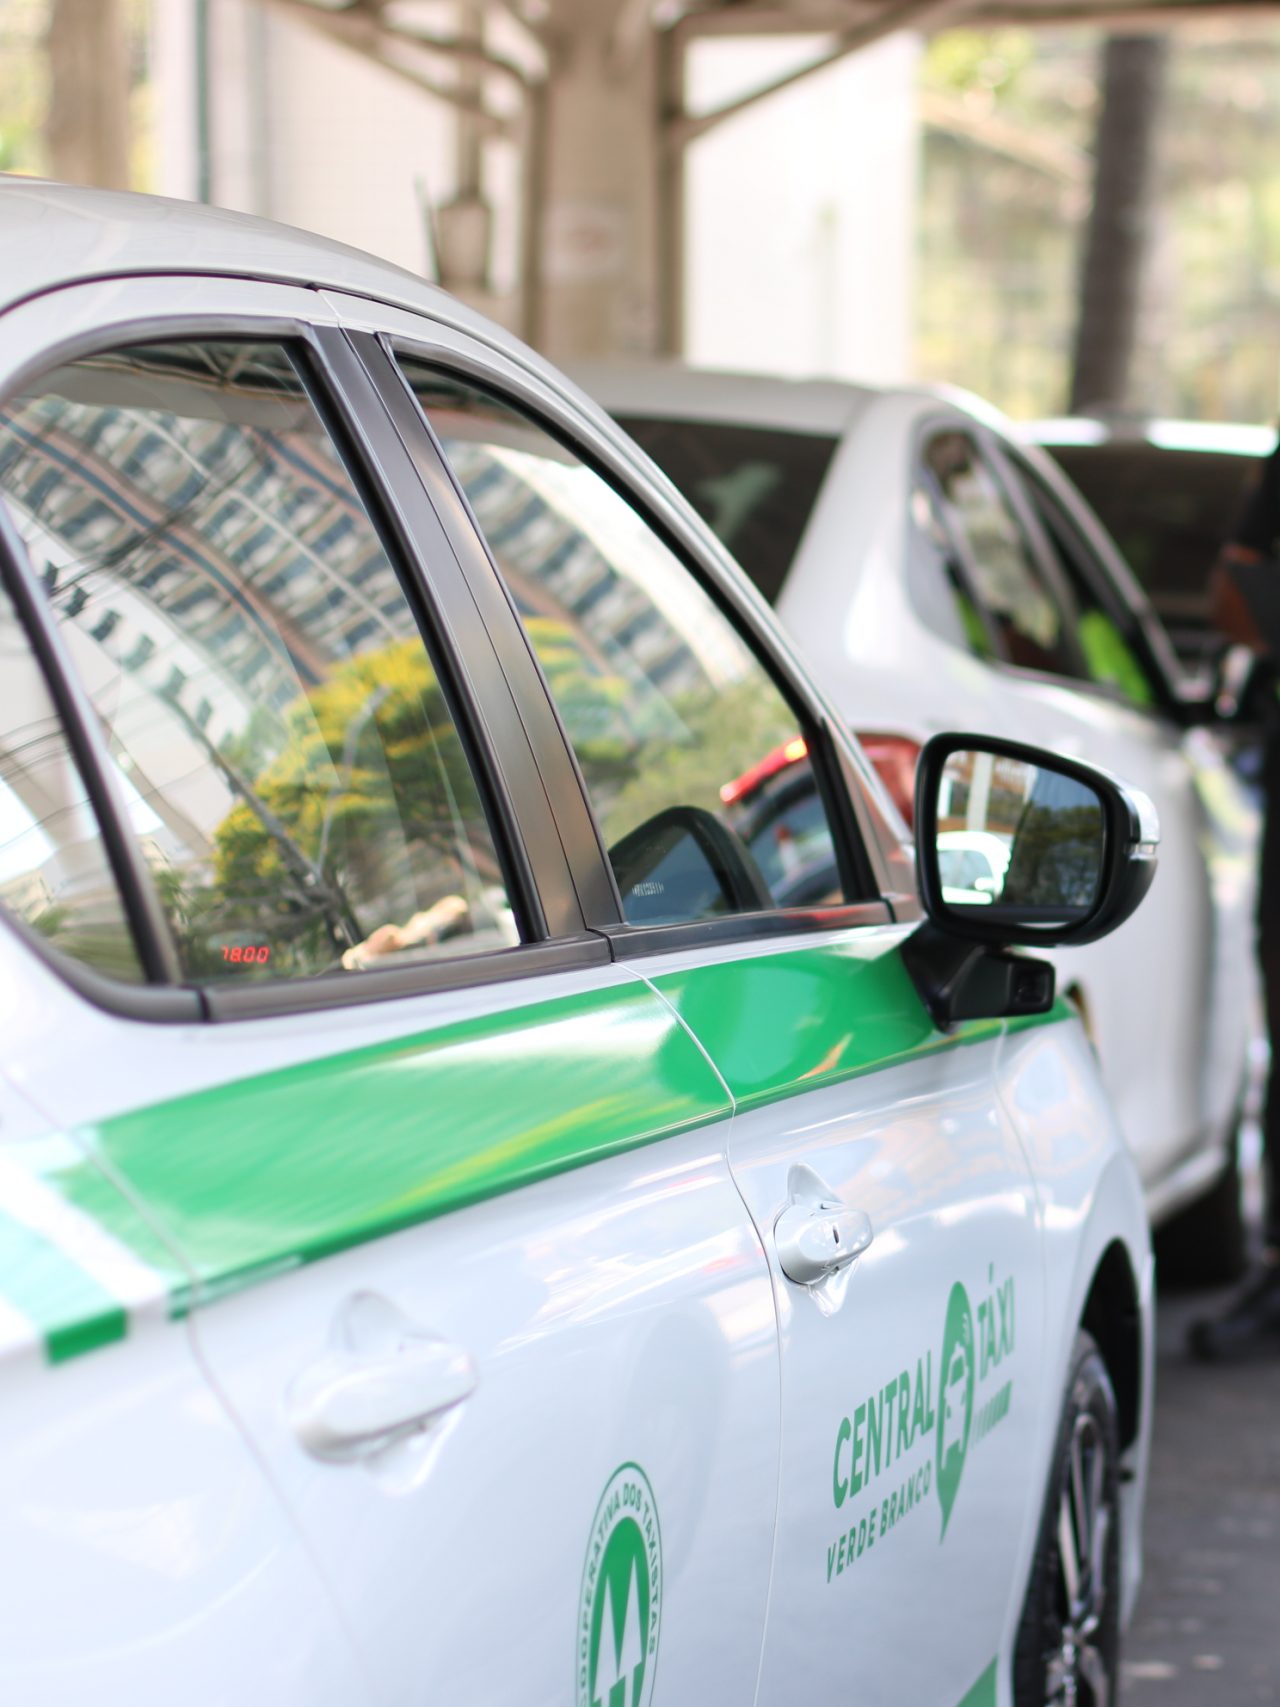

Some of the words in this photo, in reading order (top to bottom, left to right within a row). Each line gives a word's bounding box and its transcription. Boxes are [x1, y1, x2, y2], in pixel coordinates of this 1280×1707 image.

[833, 1350, 934, 1509] CENTRAL
[977, 1261, 1015, 1382] TÁXI
[622, 1482, 642, 1512] DOS
[826, 1507, 877, 1584] VERDE
[879, 1459, 932, 1537] BRANCO
